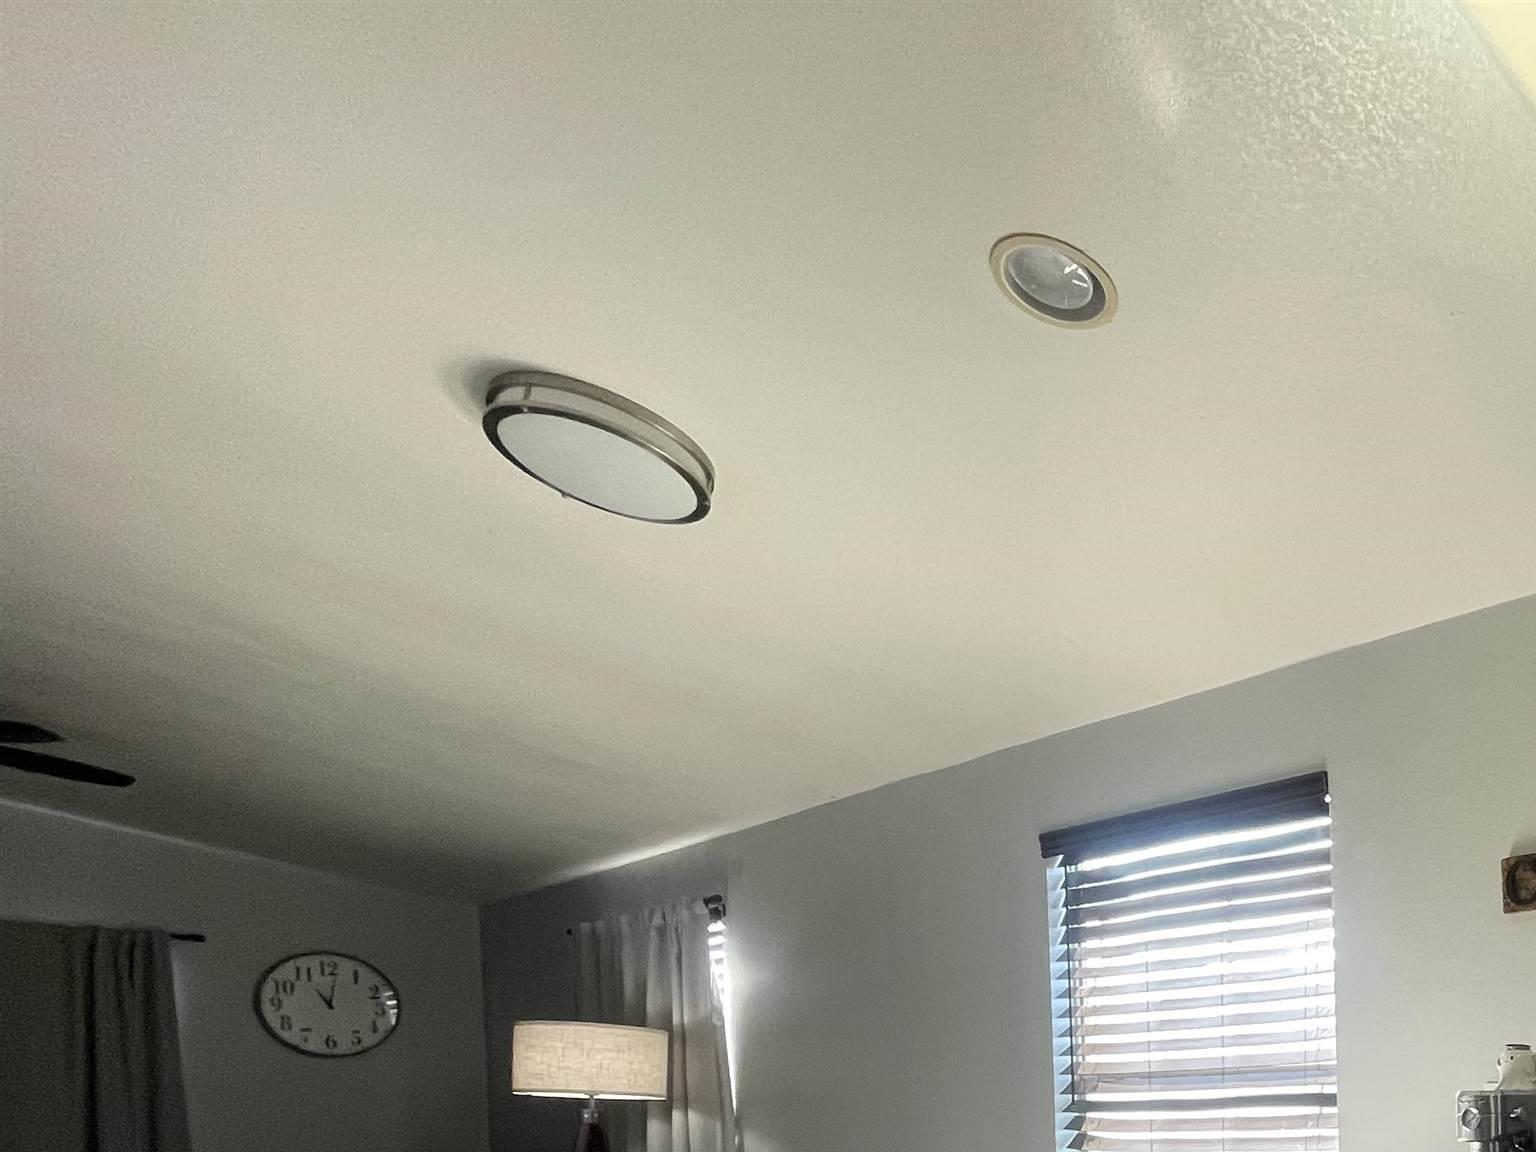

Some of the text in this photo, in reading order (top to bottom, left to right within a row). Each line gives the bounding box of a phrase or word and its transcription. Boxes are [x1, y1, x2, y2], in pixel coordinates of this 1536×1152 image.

[295, 966, 312, 982] 11
[319, 960, 339, 977] 12
[352, 969, 359, 985] 1
[272, 978, 295, 996] 10
[368, 984, 381, 1000] 2
[269, 996, 282, 1012] 9
[279, 1014, 292, 1031] 8
[325, 1034, 338, 1049] 6
[351, 1030, 362, 1046] 5
